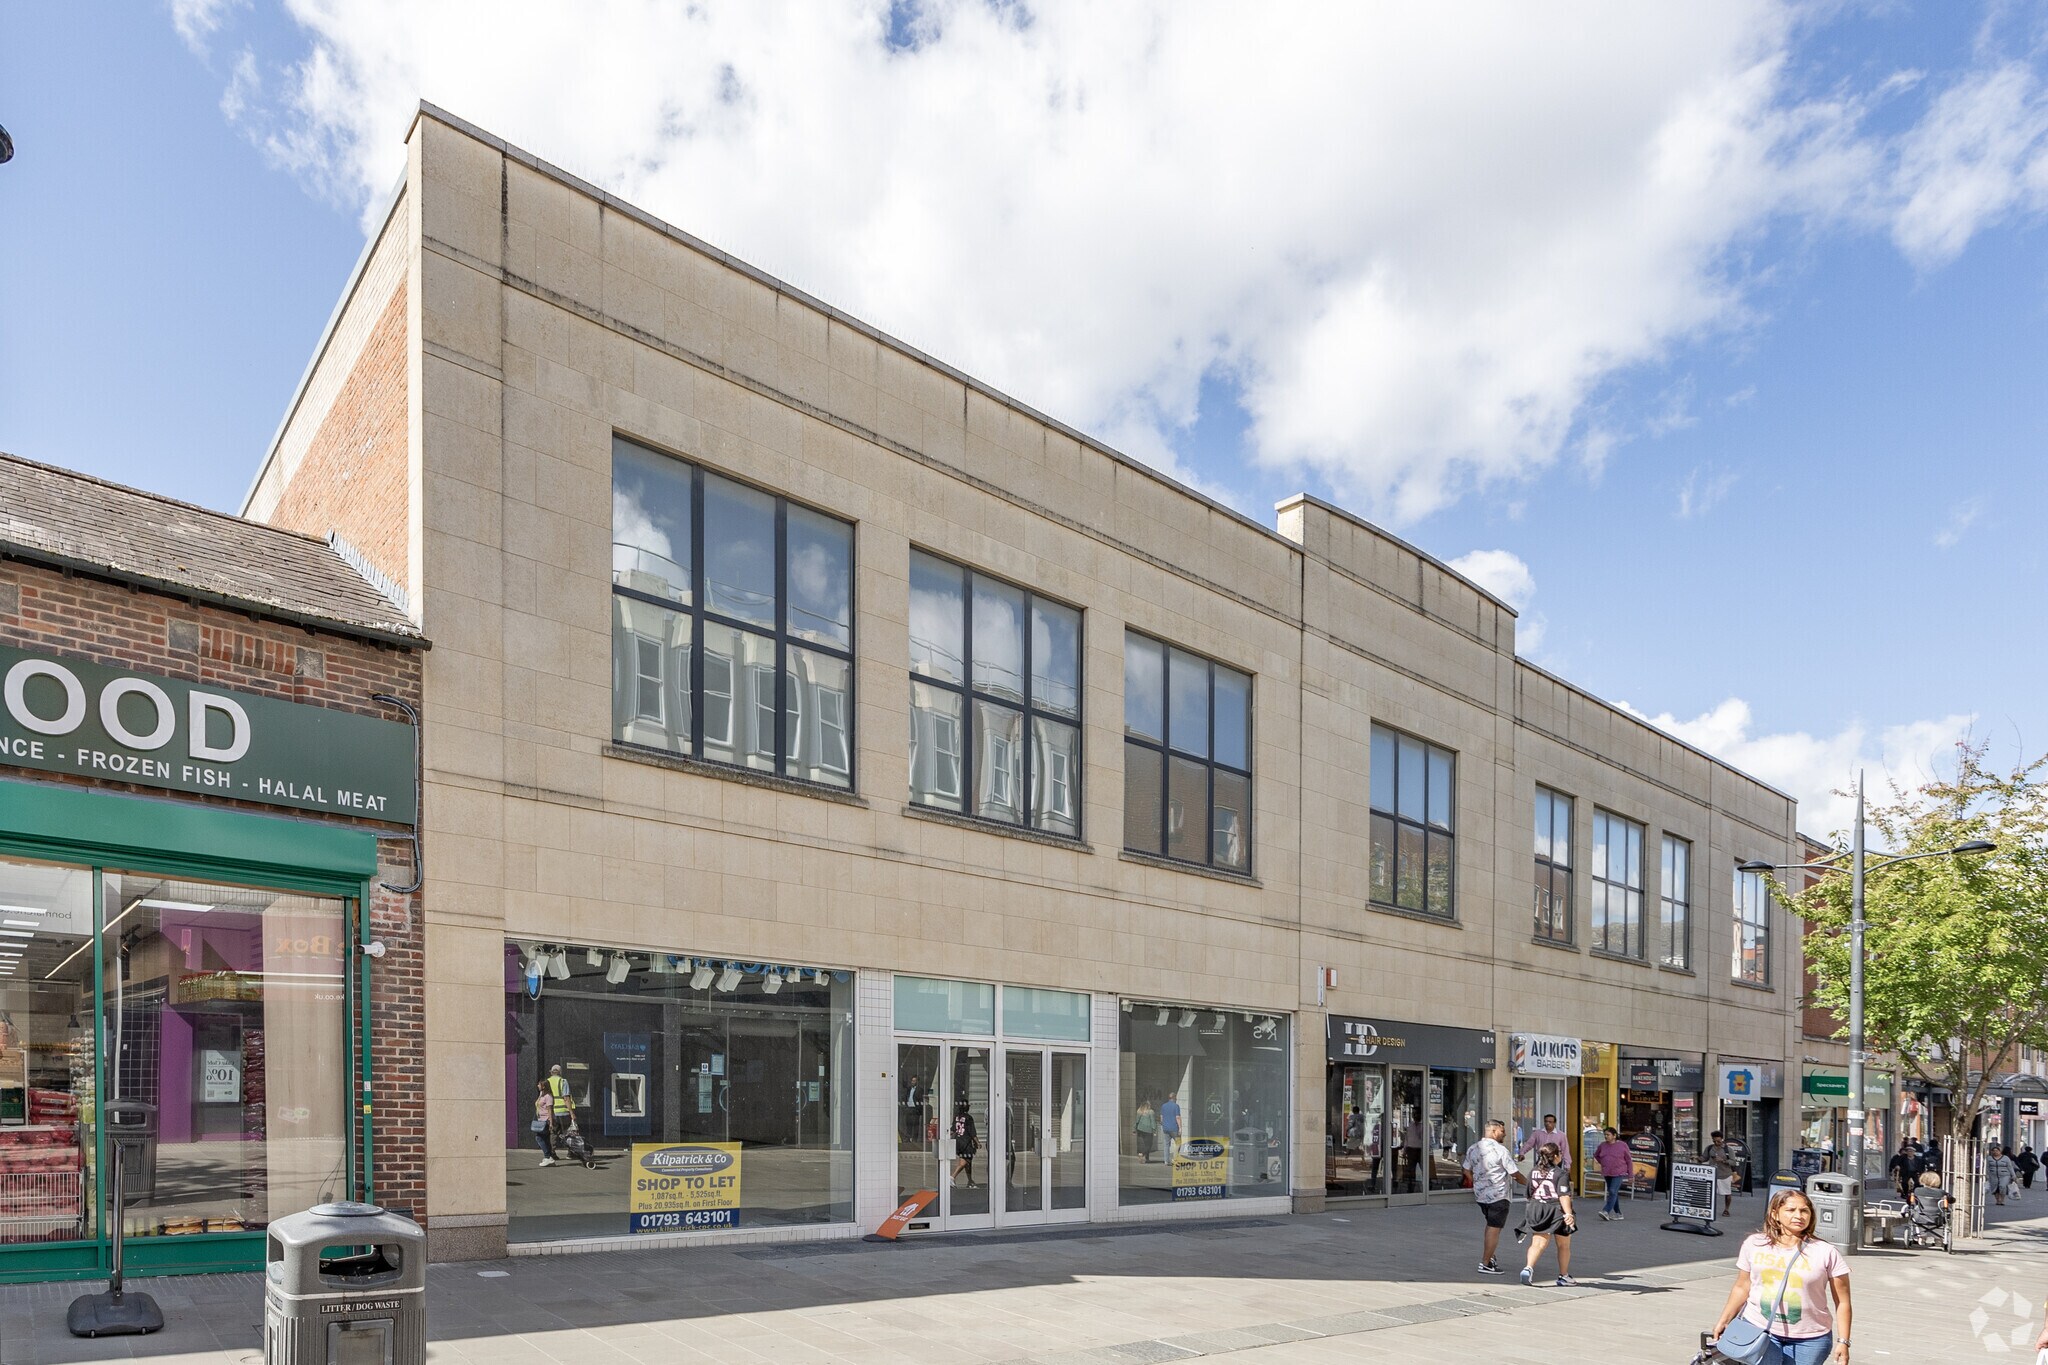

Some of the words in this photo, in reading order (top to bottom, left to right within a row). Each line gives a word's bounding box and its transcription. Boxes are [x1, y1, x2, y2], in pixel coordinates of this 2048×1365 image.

[4, 659, 251, 762] OOD
[77, 748, 170, 779] FROZEN
[182, 765, 231, 788] FISH
[259, 777, 328, 804] HALAL
[337, 790, 387, 812] MEAT
[1366, 1035, 1382, 1045] HAIR
[1382, 1037, 1406, 1047] DESIGN
[1531, 1041, 1546, 1057] AU
[1549, 1042, 1577, 1059] KUTS
[1537, 1060, 1570, 1070] BARBERS
[652, 1153, 704, 1166] Kilpatrick
[705, 1154, 712, 1163] &
[714, 1154, 727, 1163] Co
[1175, 1161, 1196, 1171] SHOP
[1198, 1161, 1208, 1170] TO
[1210, 1161, 1224, 1169] LET
[1690, 1166, 1713, 1174] KUTS
[637, 1178, 681, 1191] SHOP
[685, 1177, 704, 1189] TO
[709, 1176, 736, 1188] LET
[1176, 1187, 1196, 1197] 01793
[1198, 1185, 1221, 1195] 643101
[638, 1202, 652, 1210] Plus
[640, 1213, 680, 1227] 01793
[685, 1211, 731, 1224] 643101
[1754, 1252, 1811, 1272] OSAA
[321, 1304, 351, 1313] LITTER
[356, 1301, 373, 1311] DOG
[374, 1300, 400, 1309] WASTE
